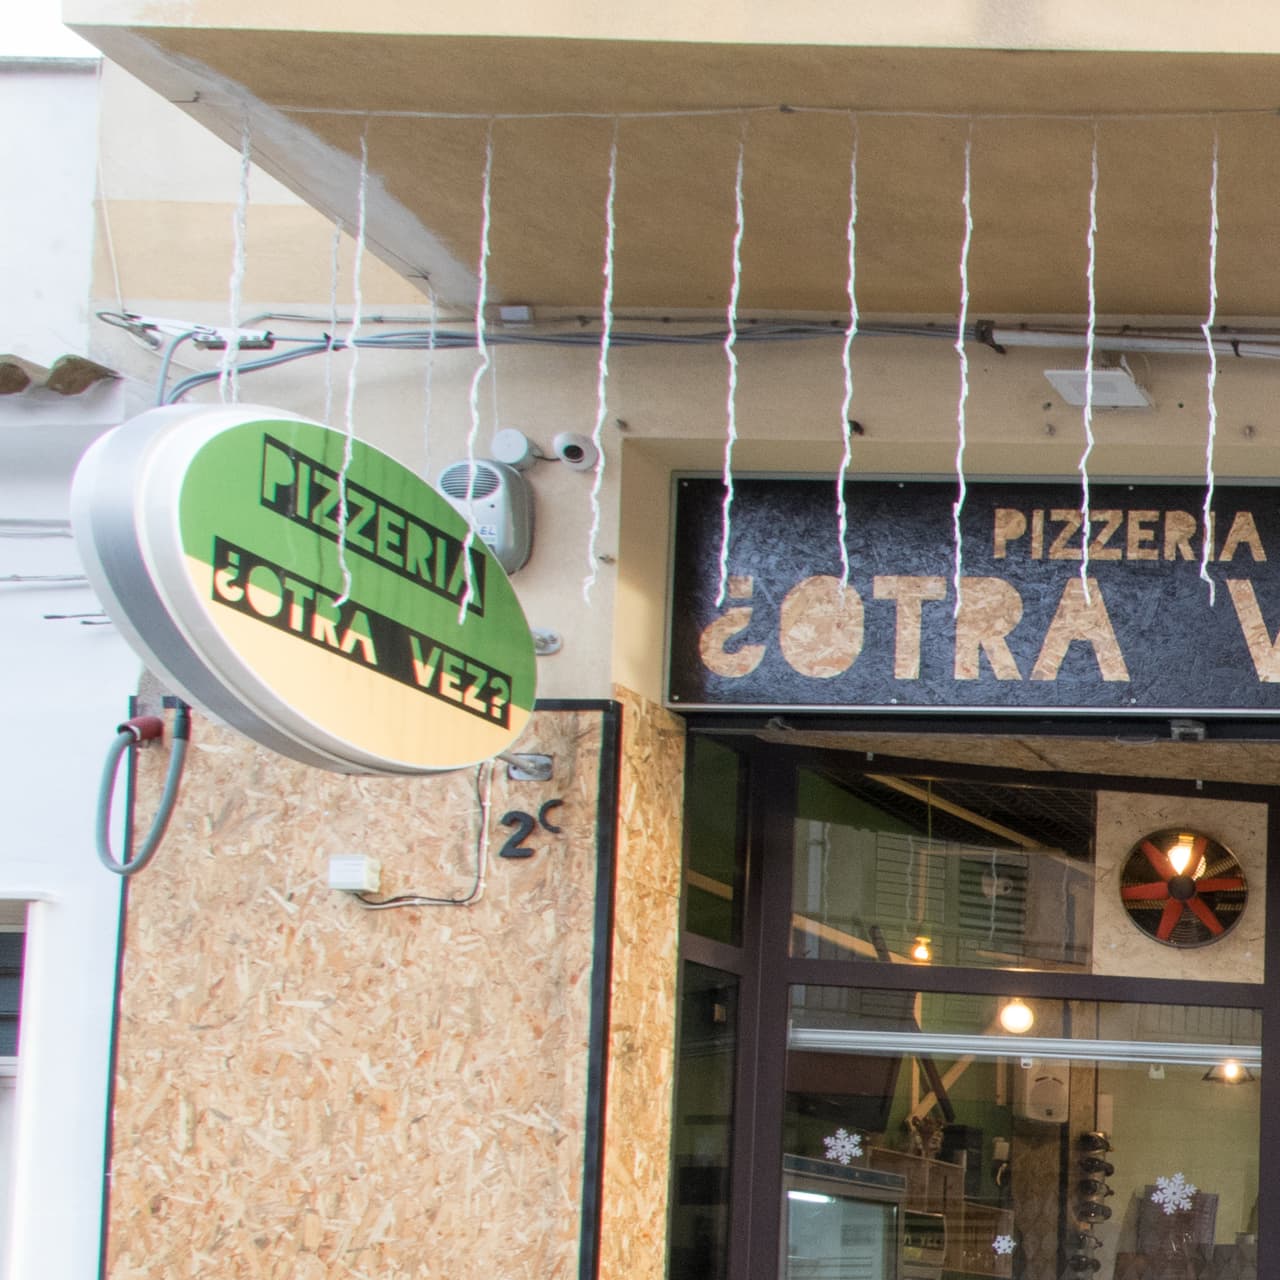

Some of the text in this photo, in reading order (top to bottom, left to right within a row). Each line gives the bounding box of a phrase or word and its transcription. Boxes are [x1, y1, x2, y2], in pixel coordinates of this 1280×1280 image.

[263, 441, 483, 611] PIZZERIA
[993, 508, 1268, 562] PIZZERIA
[214, 550, 511, 721] ¿OTRA VEZ?
[697, 575, 1131, 684] ¿OTRA
